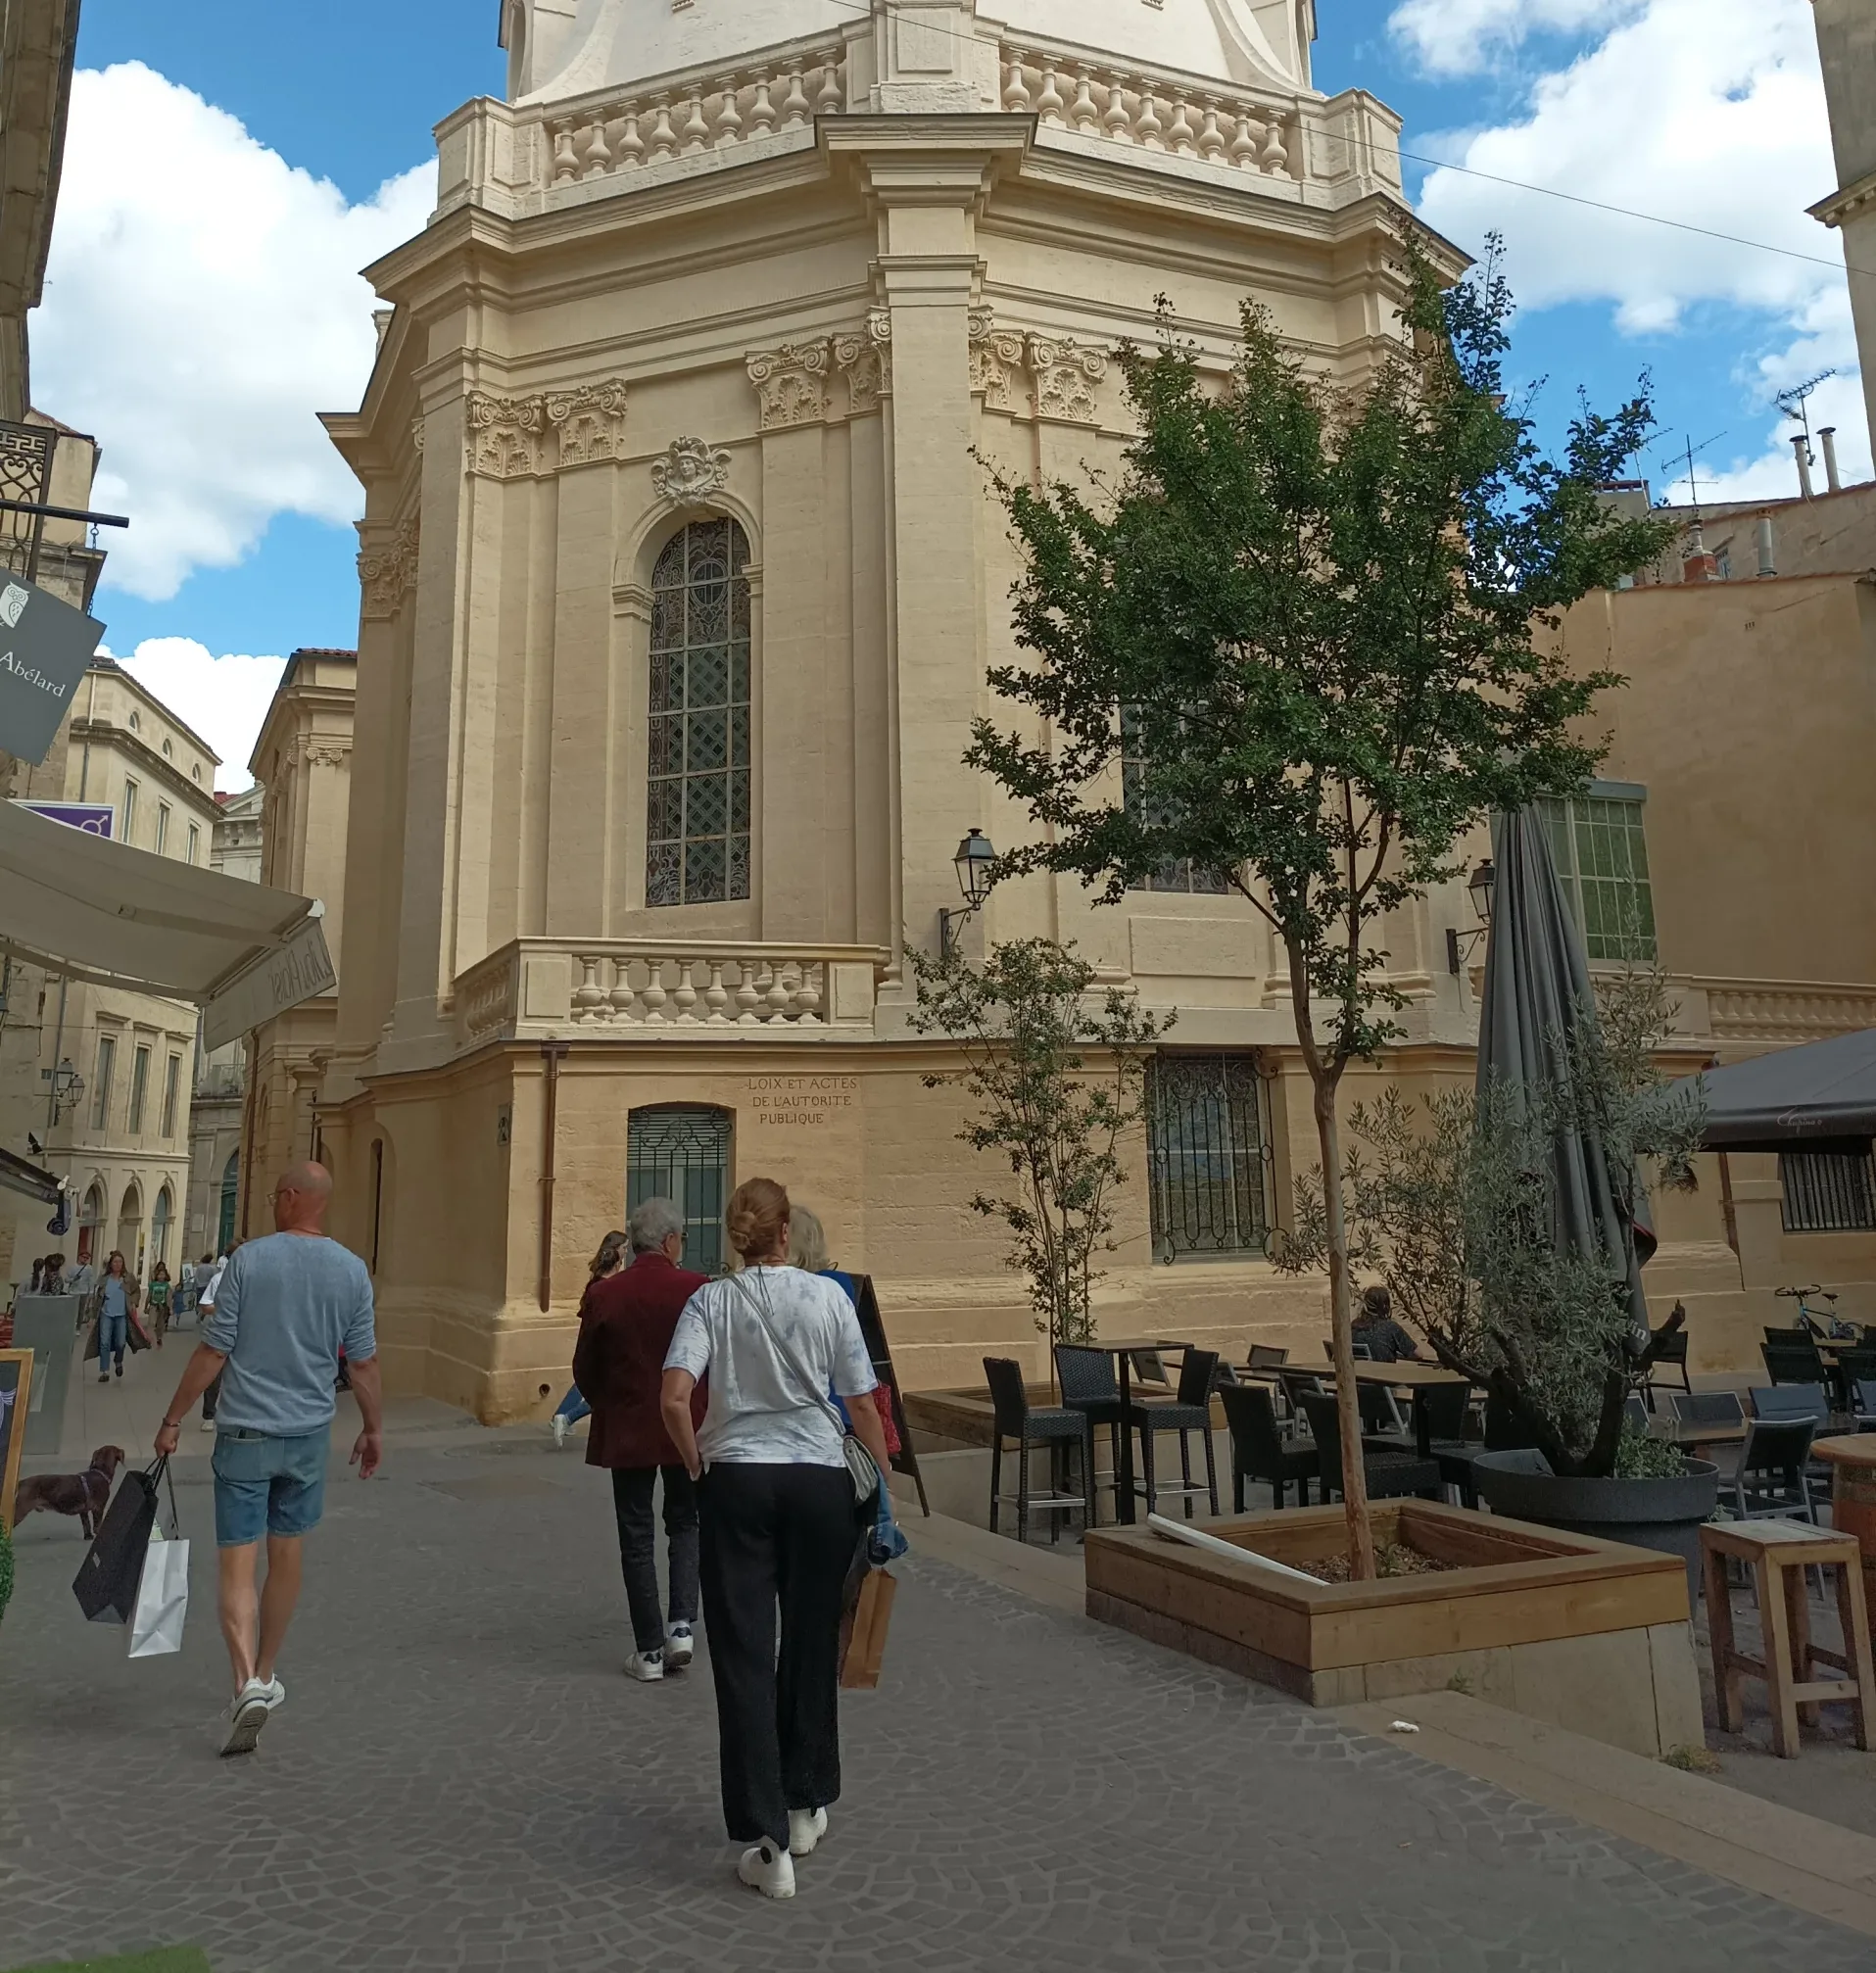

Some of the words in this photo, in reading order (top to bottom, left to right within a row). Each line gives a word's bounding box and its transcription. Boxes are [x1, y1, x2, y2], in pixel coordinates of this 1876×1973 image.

[0, 650, 66, 697] Abélard
[747, 1078, 783, 1090] LOIX
[788, 1079, 805, 1089] ET
[809, 1078, 857, 1089] ACTES
[752, 1096, 770, 1107] DE
[759, 1113, 824, 1125] PUBLIQUE
